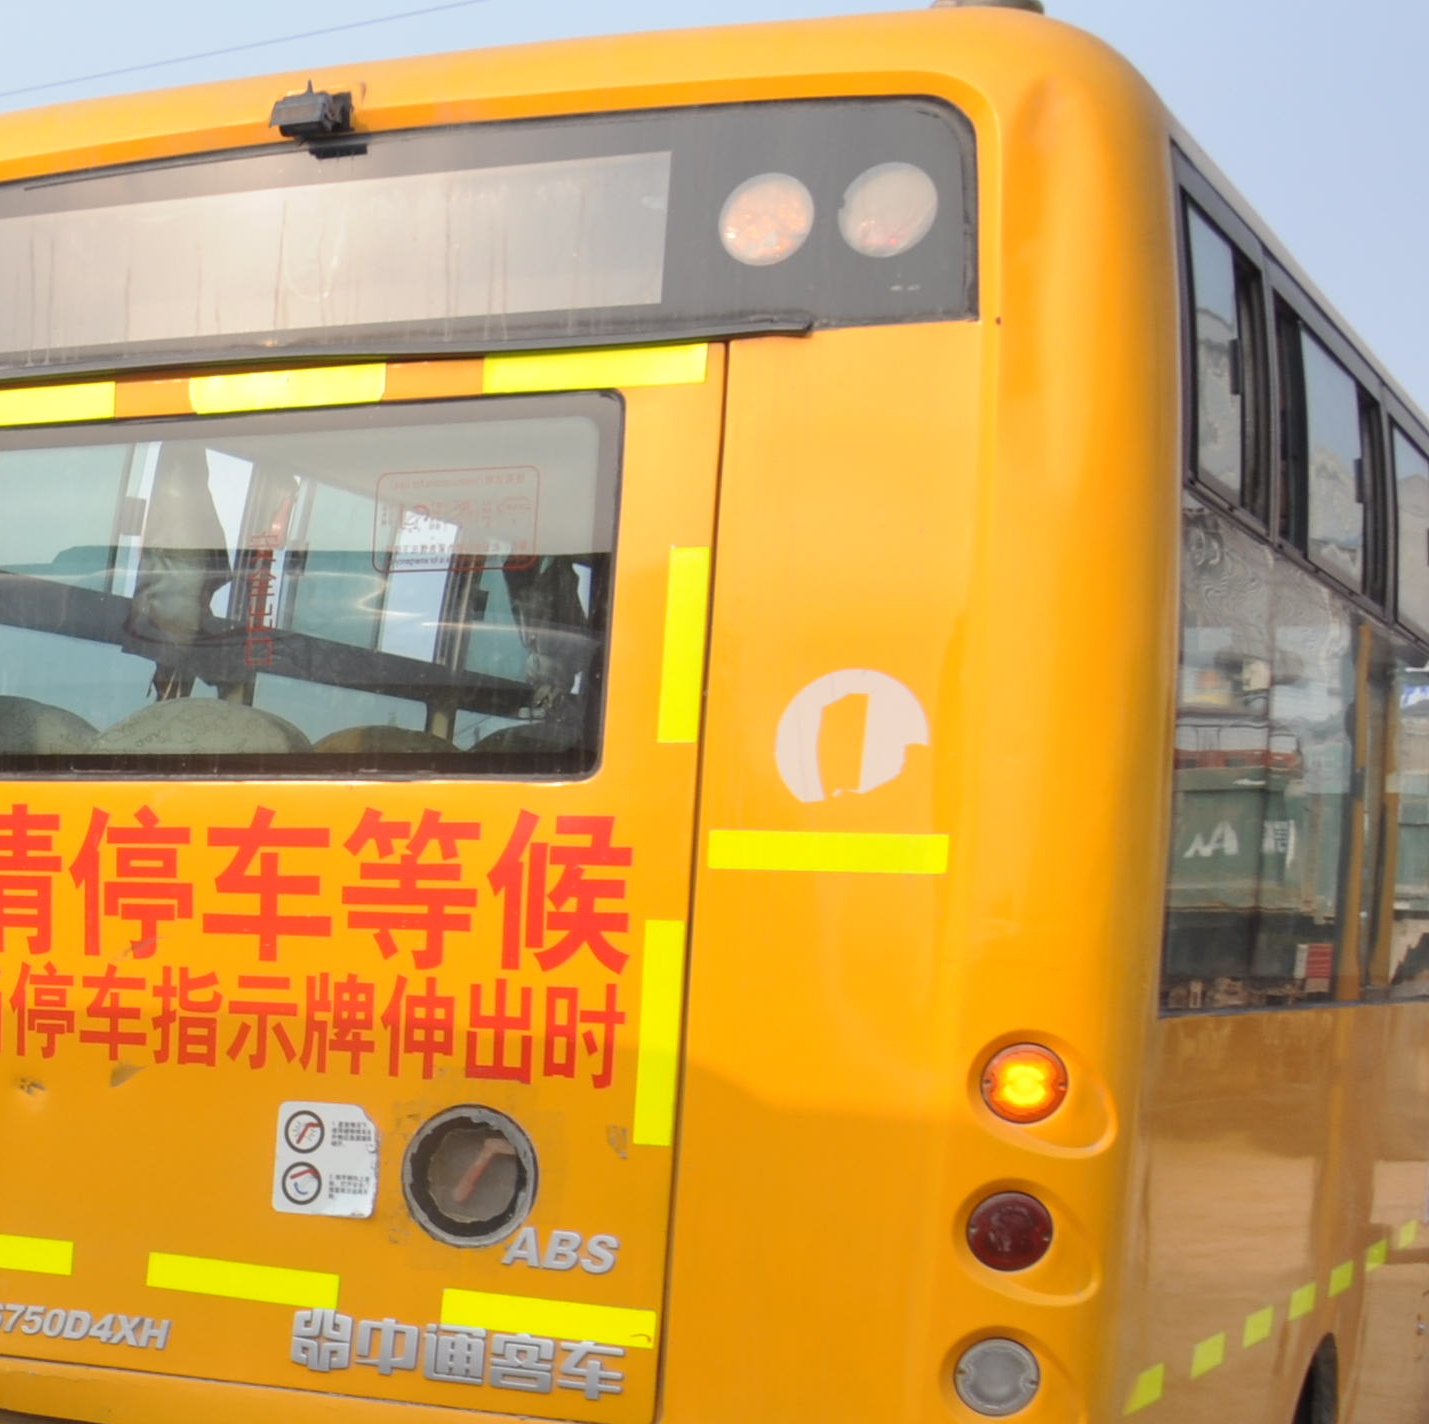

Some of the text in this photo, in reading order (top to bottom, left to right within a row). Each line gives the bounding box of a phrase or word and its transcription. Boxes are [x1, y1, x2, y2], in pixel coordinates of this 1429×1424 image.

[501, 1227, 619, 1274] ABS
[356, 1317, 626, 1400] 中通客车
